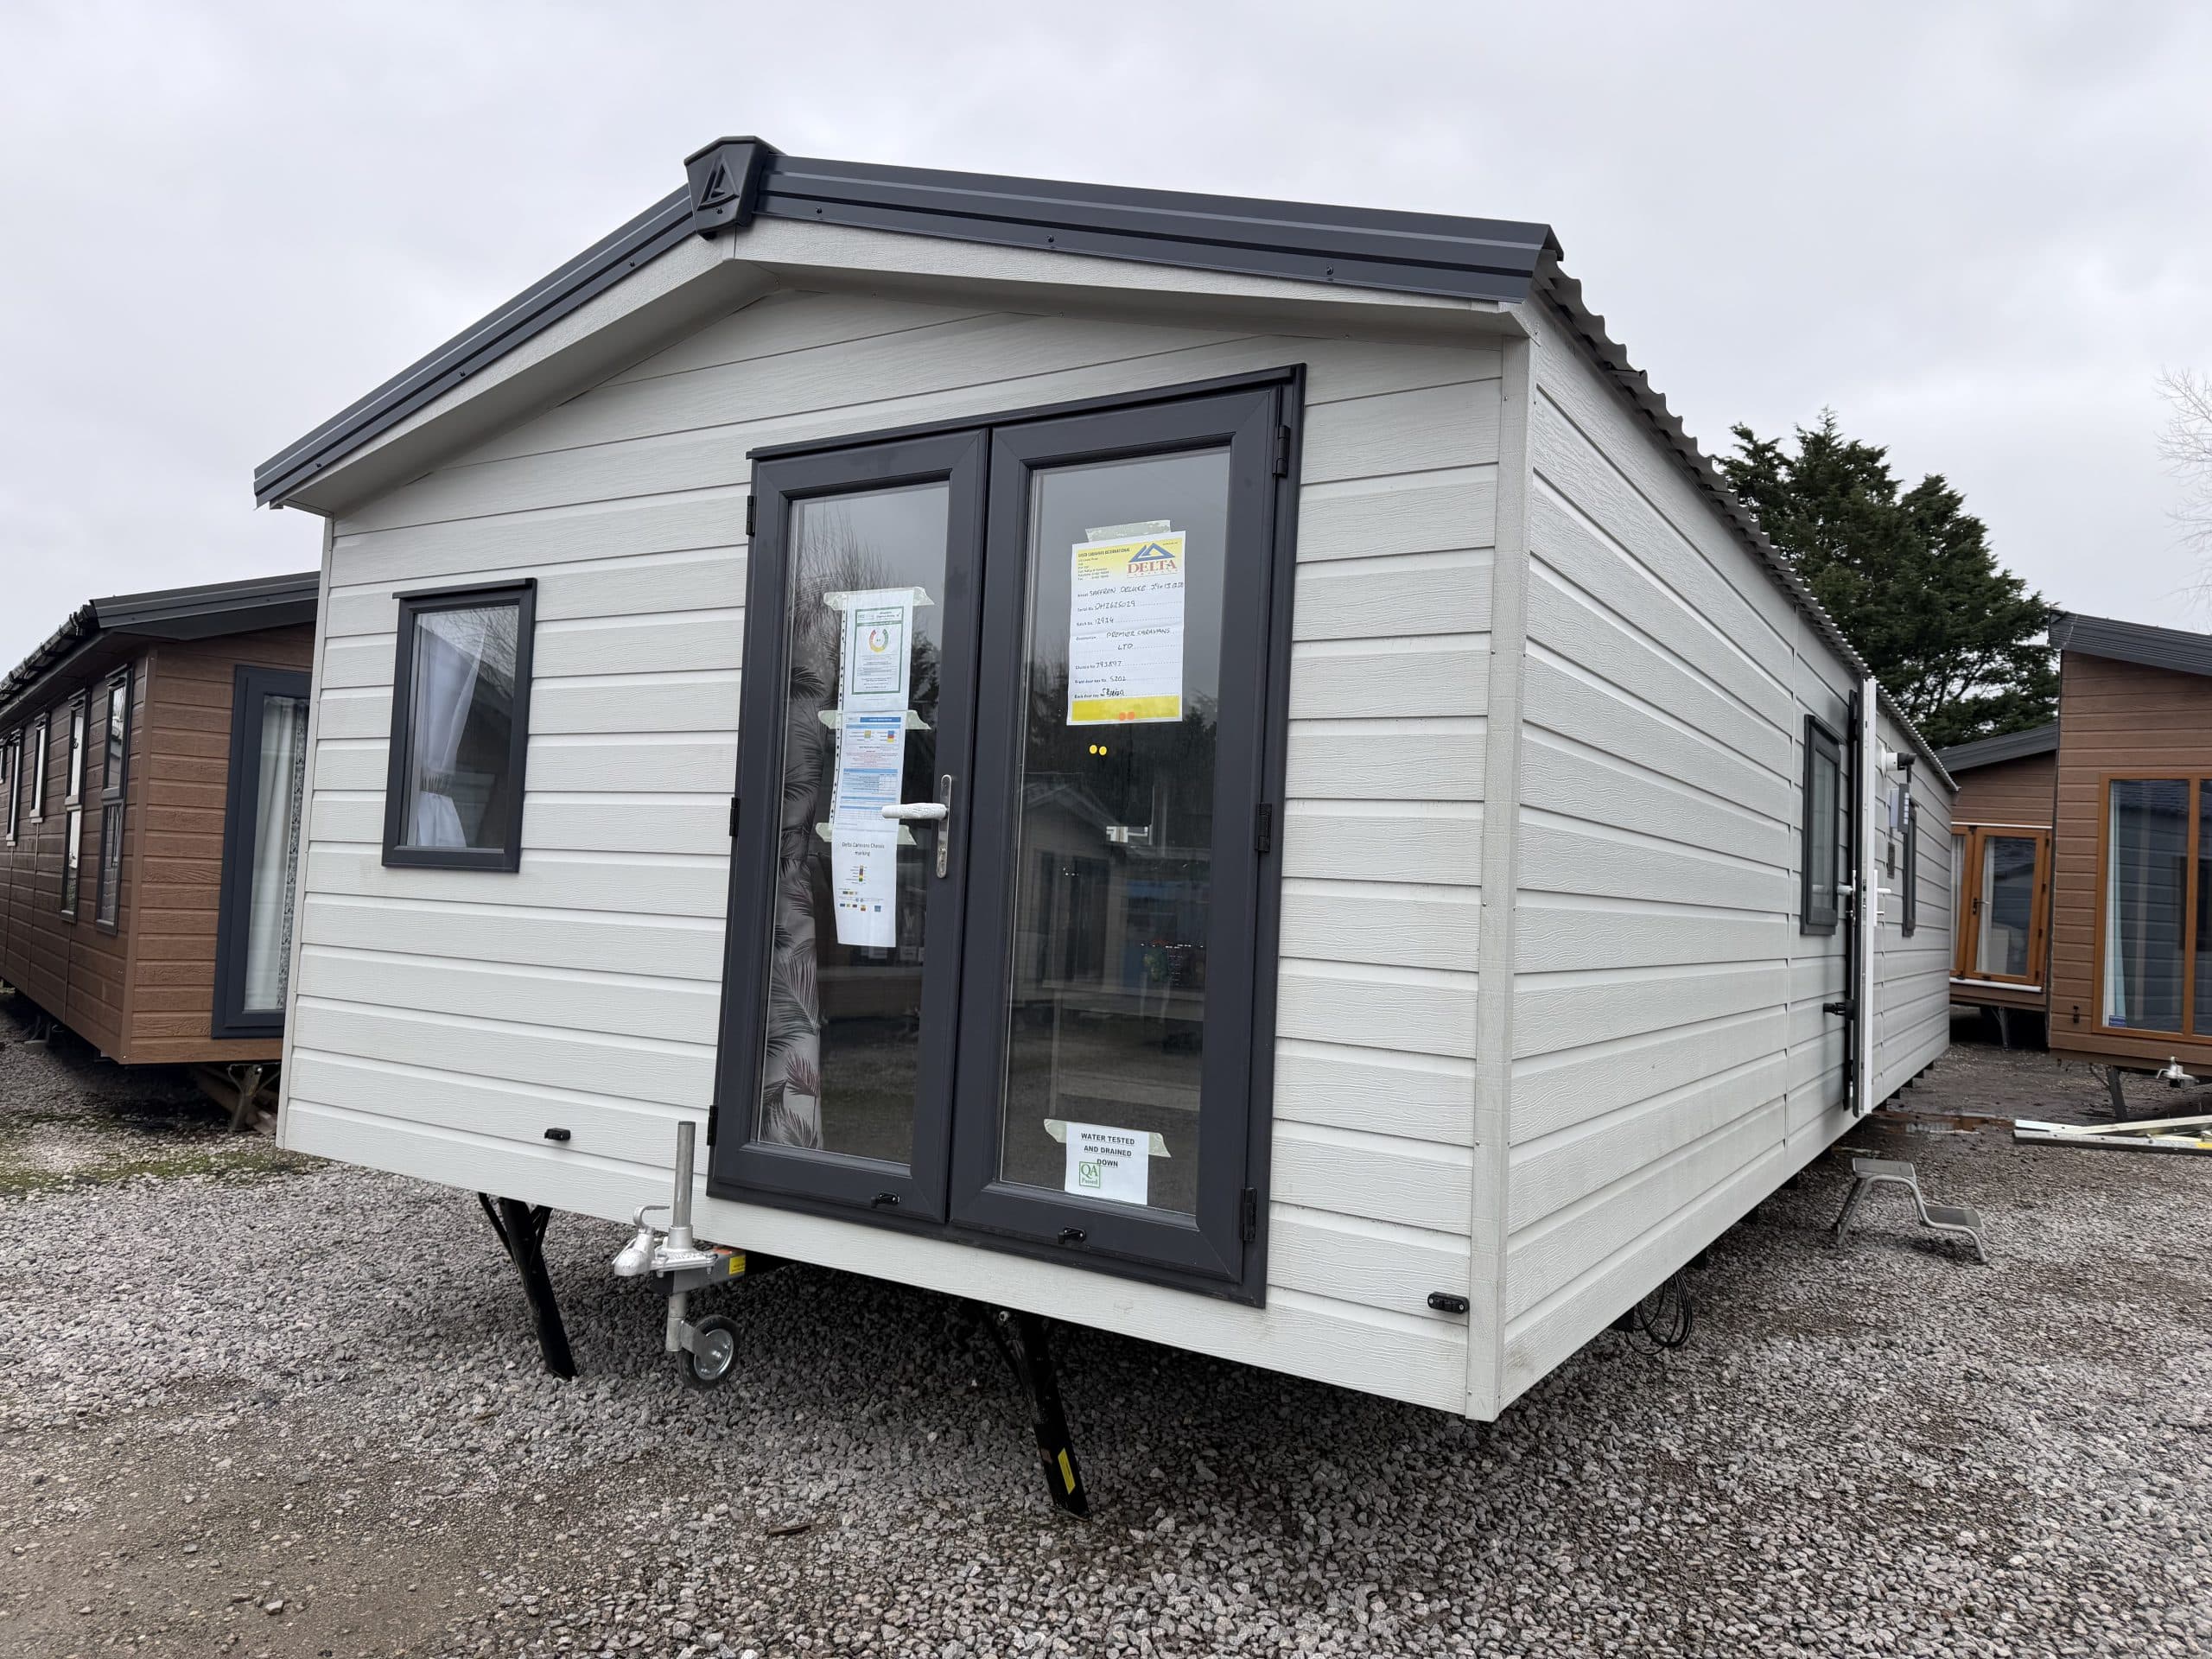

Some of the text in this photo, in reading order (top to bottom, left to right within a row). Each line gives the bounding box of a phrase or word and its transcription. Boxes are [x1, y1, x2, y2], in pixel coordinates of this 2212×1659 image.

[1128, 559, 1177, 574] DELTA
[1081, 1133, 1135, 1145] WATER TESTED
[1084, 1145, 1132, 1157] AND DRAINED
[1096, 1159, 1119, 1168] DOWN
[1080, 1164, 1099, 1179] QA
